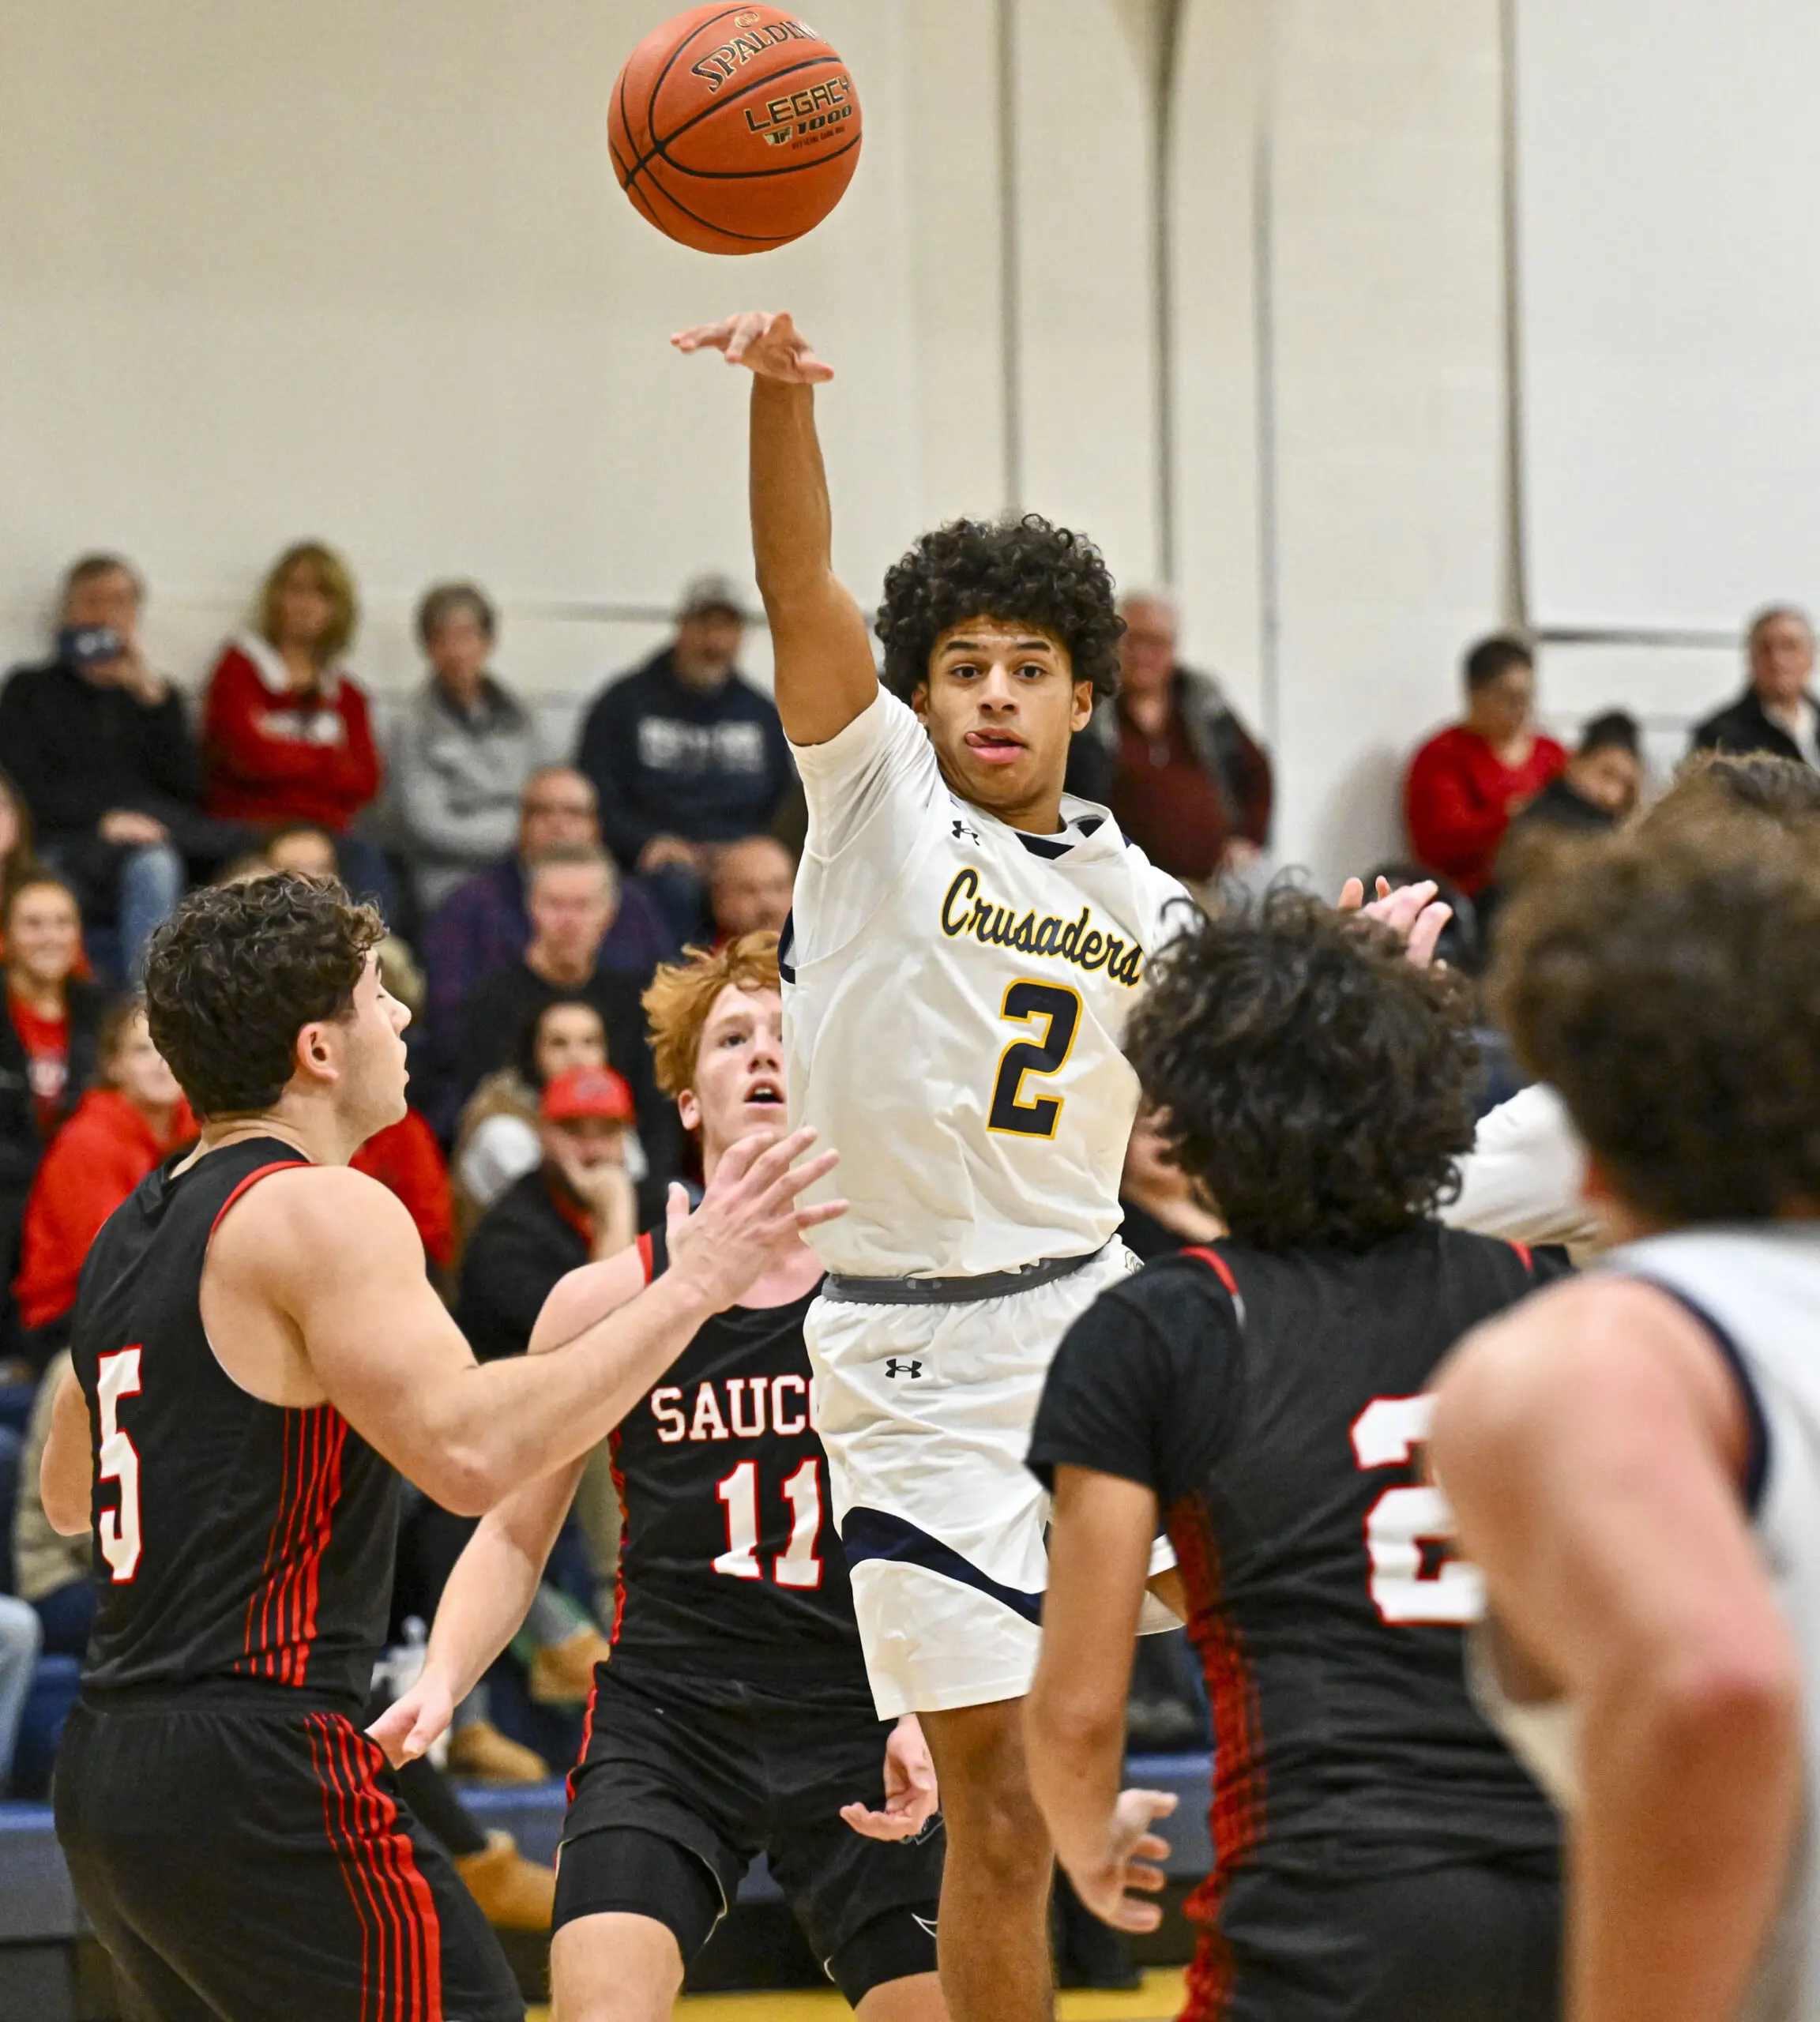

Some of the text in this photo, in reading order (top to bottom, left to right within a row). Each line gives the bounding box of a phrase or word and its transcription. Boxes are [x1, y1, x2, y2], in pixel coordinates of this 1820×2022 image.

[691, 21, 823, 93] SPALDIN
[744, 74, 851, 133] LEGACY
[941, 866, 1146, 989] Crusaders
[986, 977, 1083, 1141] 2
[97, 1344, 142, 1584] 5
[650, 1374, 819, 1443] SAUC
[711, 1456, 823, 1591] 11
